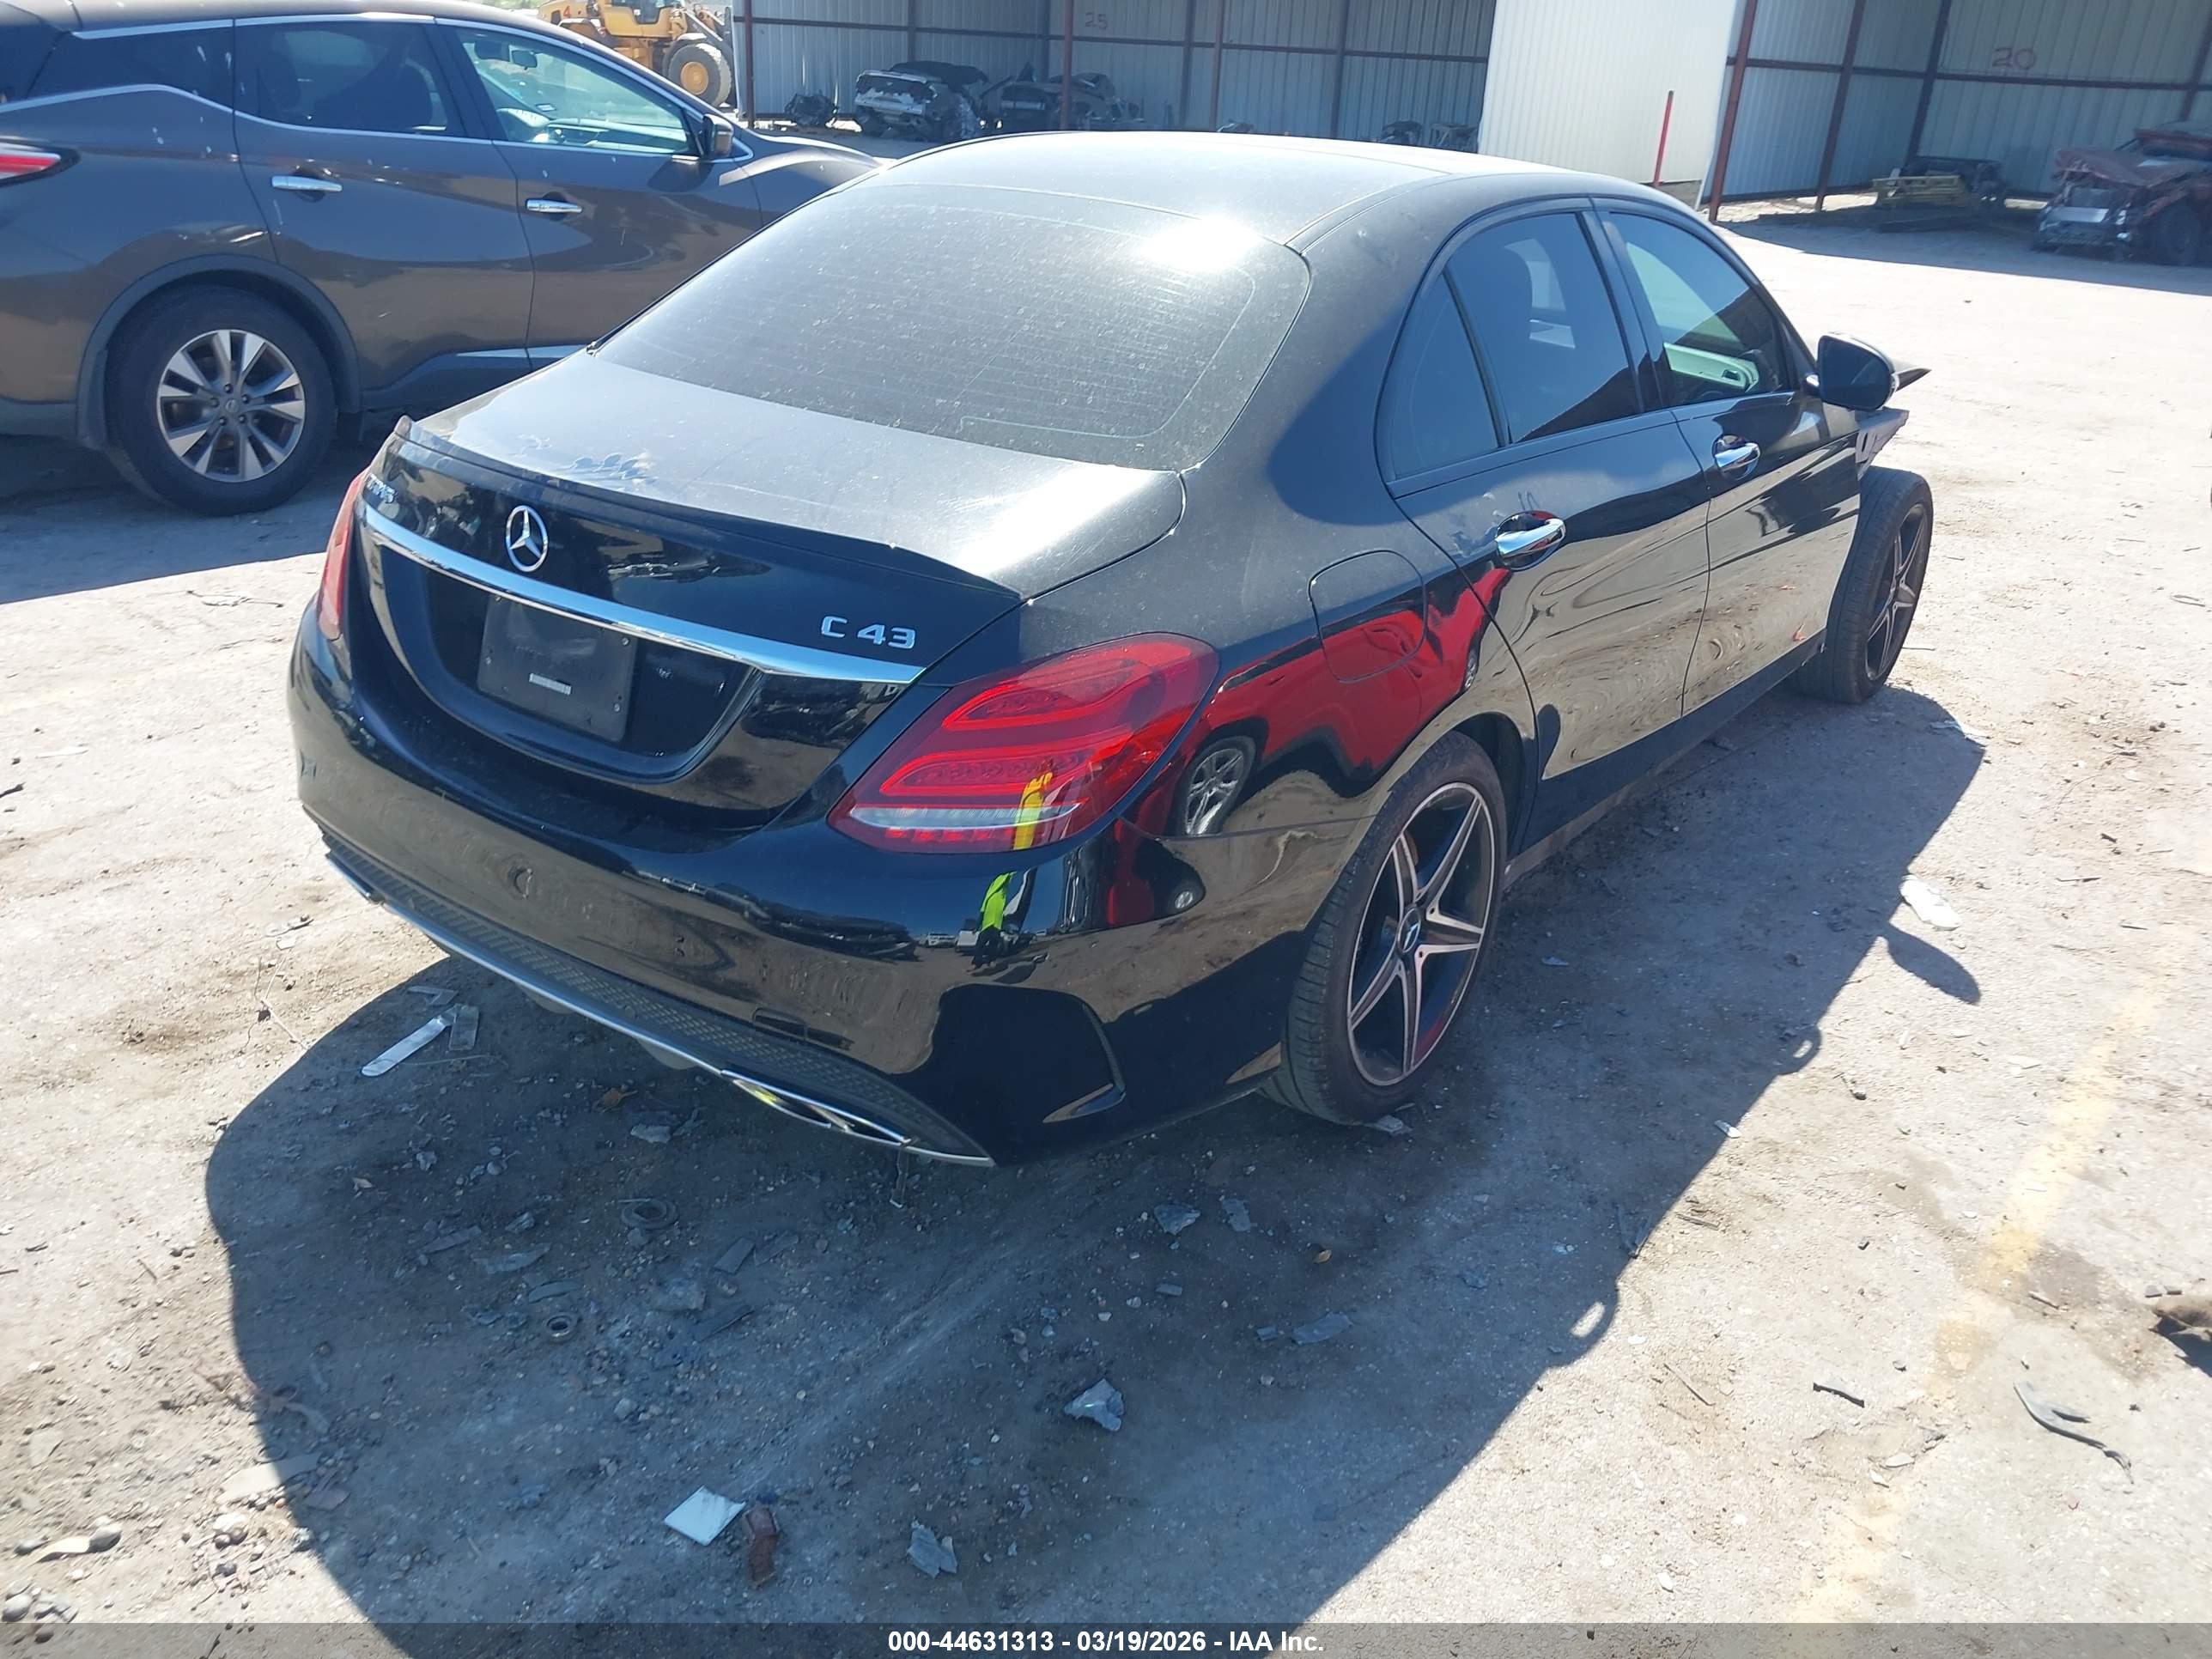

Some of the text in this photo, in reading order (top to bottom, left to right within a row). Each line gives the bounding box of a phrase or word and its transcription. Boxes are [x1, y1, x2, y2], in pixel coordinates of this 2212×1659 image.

[1085, 12, 1108, 30] 25
[1992, 46, 2037, 70] 20
[821, 616, 916, 649] C 43
